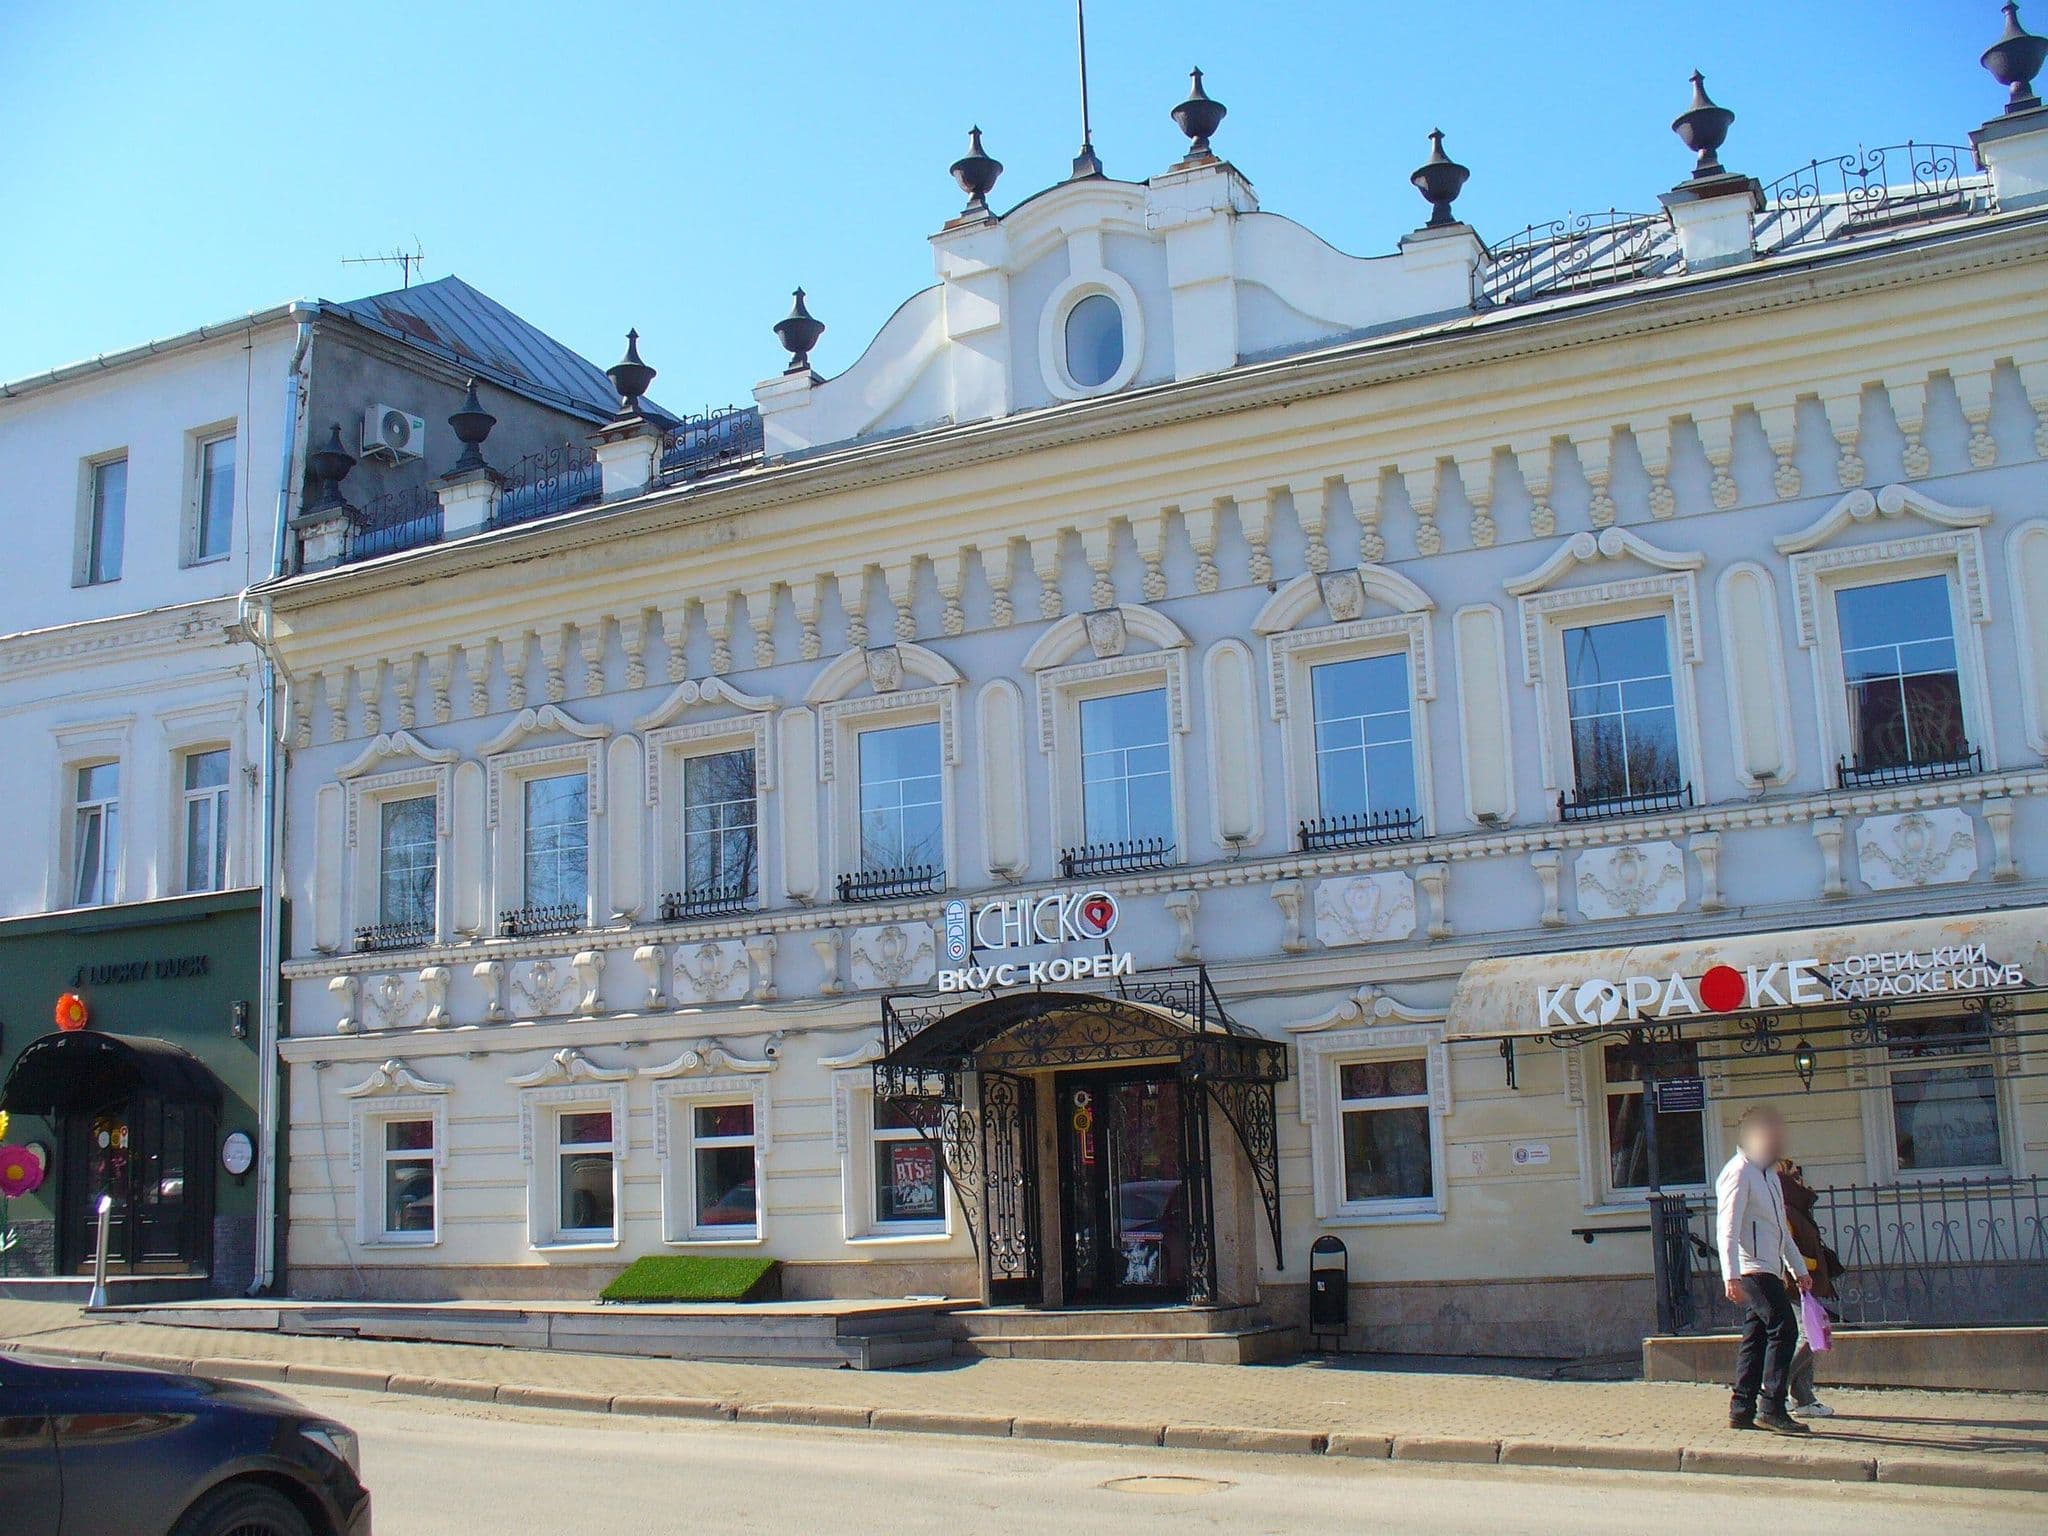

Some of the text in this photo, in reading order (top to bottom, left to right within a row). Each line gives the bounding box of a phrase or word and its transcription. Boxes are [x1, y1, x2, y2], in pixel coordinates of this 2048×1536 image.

[947, 901, 965, 959] CHICKO
[977, 891, 1119, 950] CHICKO
[88, 954, 209, 985] LUCKY DUCK
[938, 952, 1135, 992] ВКУС КОРЕИ
[1831, 964, 2024, 1001] КАРАОКЕ КЛУБ
